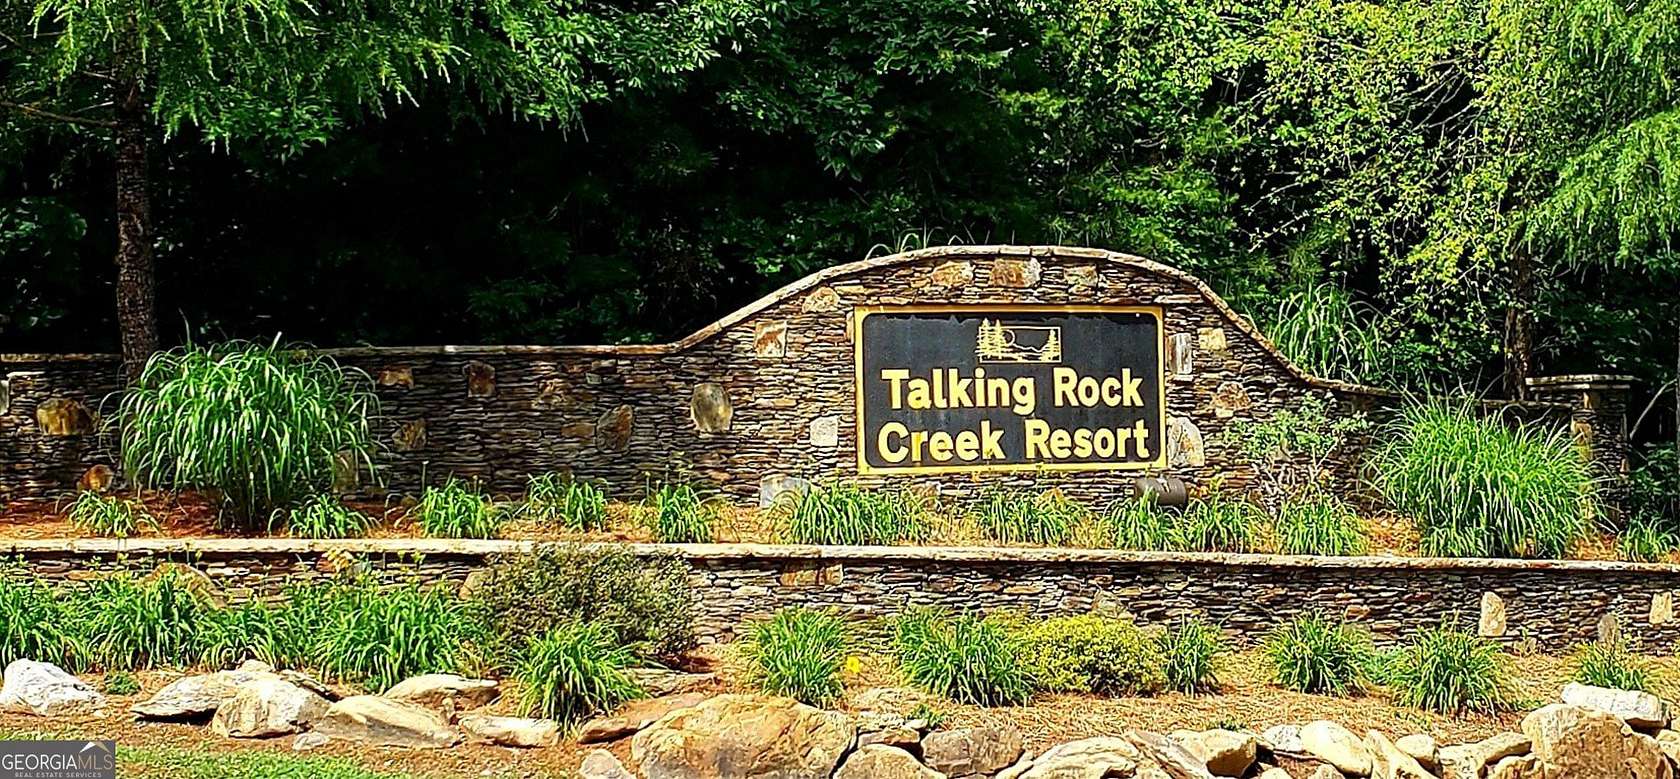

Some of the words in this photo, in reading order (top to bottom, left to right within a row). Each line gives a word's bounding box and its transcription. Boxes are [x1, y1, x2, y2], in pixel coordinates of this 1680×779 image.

[881, 367, 1035, 416] Talking
[1053, 366, 1144, 408] Rock
[877, 419, 1006, 463] Creek
[1024, 418, 1150, 459] Resort
